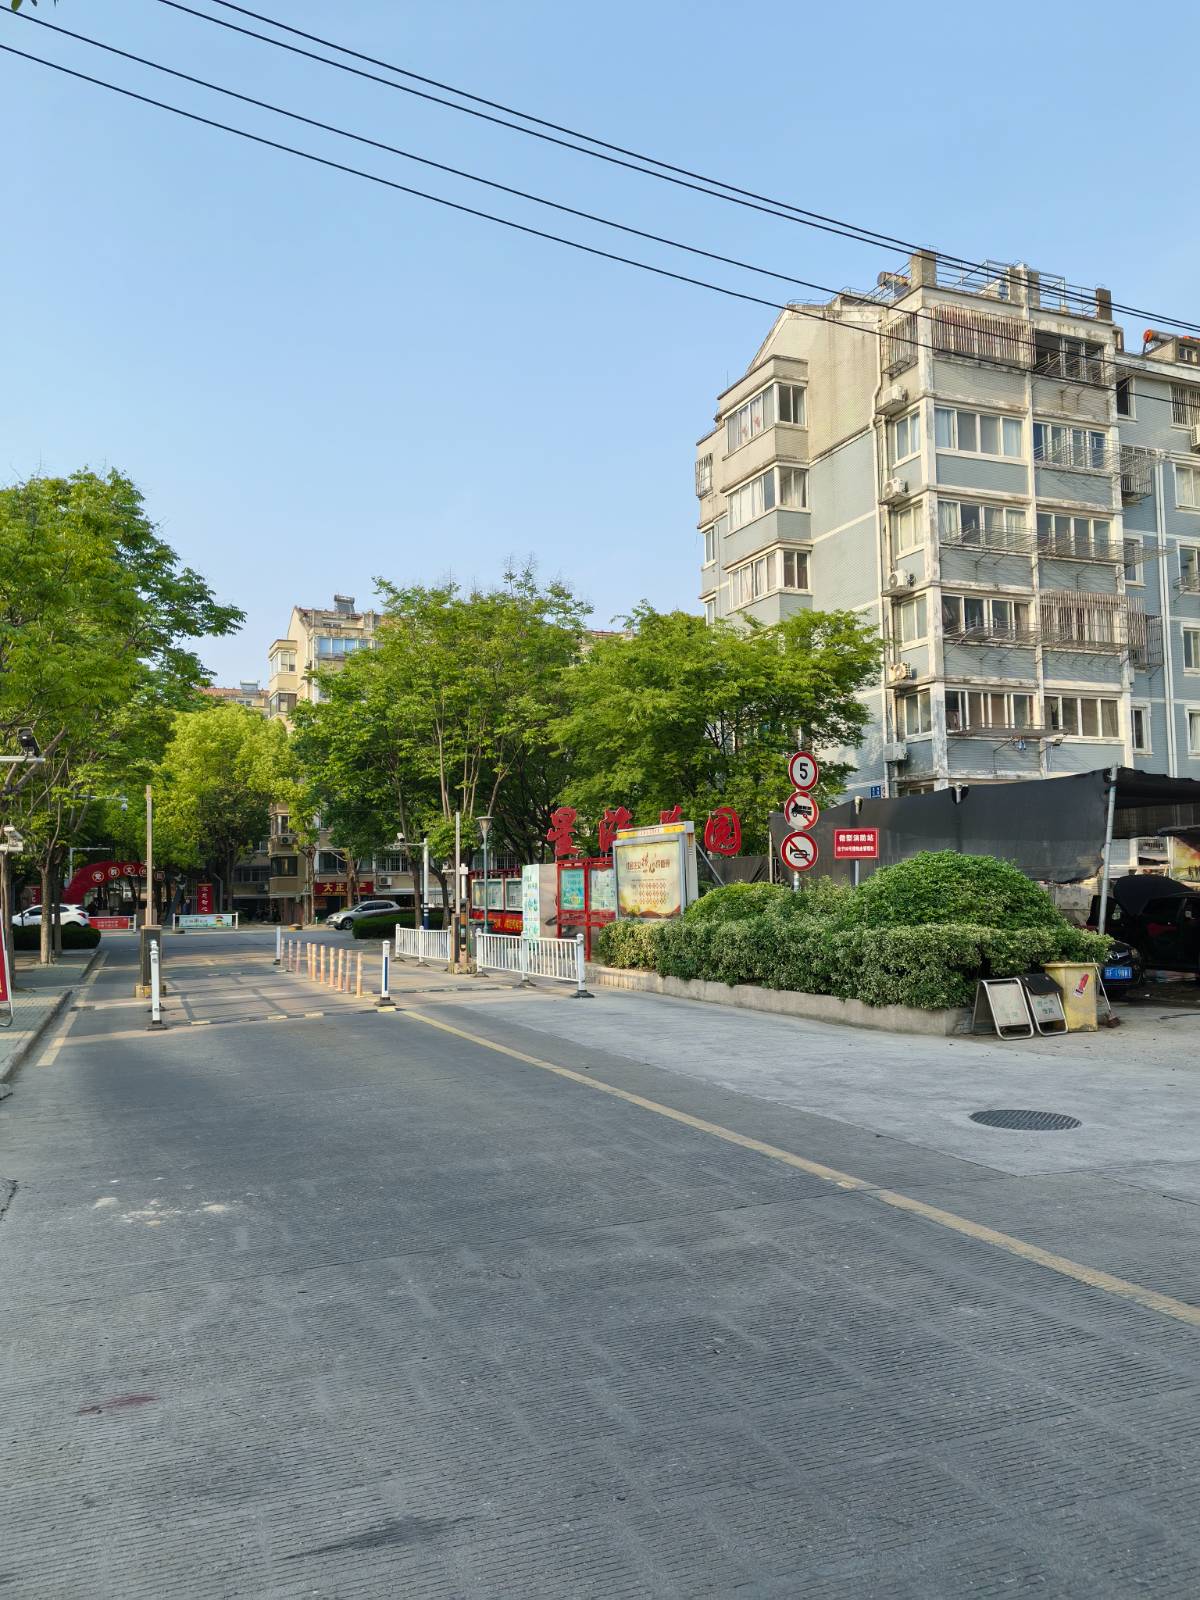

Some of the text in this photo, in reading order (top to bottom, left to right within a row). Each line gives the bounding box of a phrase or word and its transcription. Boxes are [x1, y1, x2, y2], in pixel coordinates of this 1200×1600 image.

[800, 762, 808, 780] 5
[839, 834, 874, 842] 微型消防站
